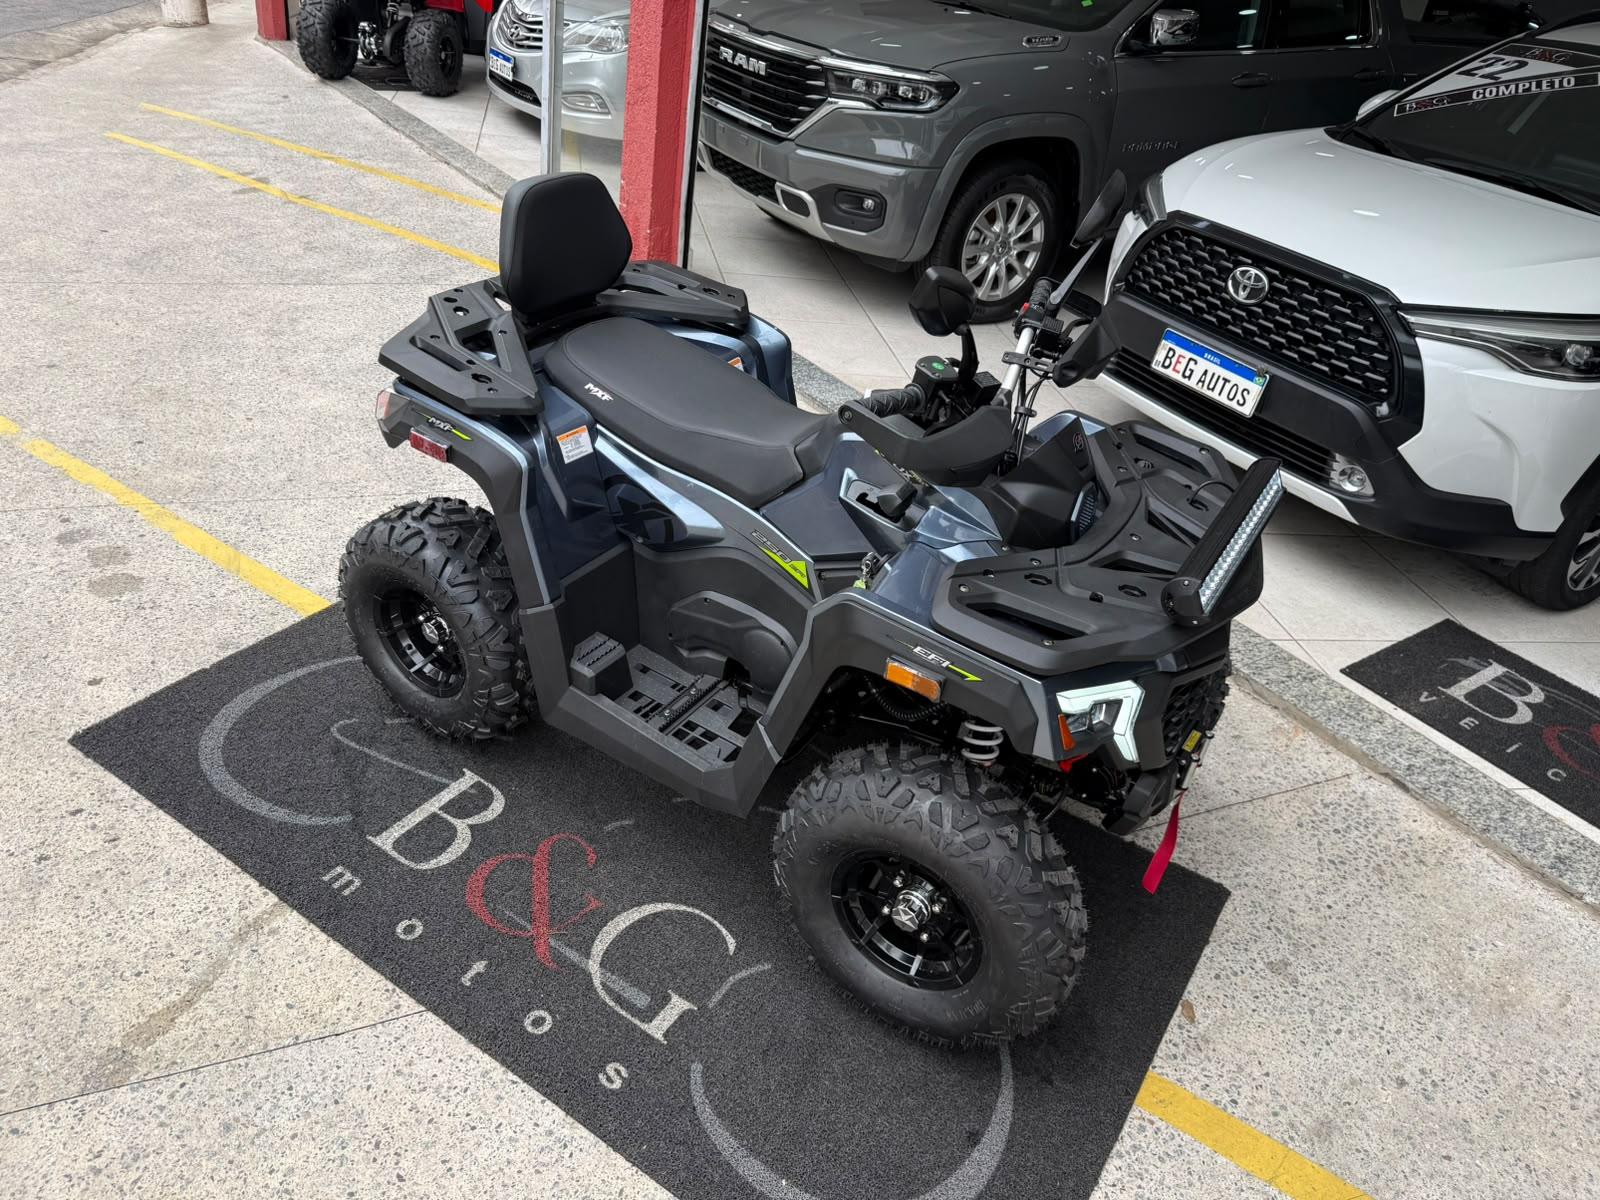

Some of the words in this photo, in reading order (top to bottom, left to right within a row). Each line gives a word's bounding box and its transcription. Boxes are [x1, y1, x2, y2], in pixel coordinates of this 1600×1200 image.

[719, 46, 767, 76] RAM
[1472, 76, 1576, 100] COMPLETO
[584, 383, 613, 400] MXF
[1161, 346, 1198, 381] BEG
[1196, 369, 1250, 407] AUTOS
[751, 529, 792, 563] 250
[912, 646, 951, 667] EFI
[366, 768, 737, 1044] B&G
[322, 865, 629, 1090] motos
